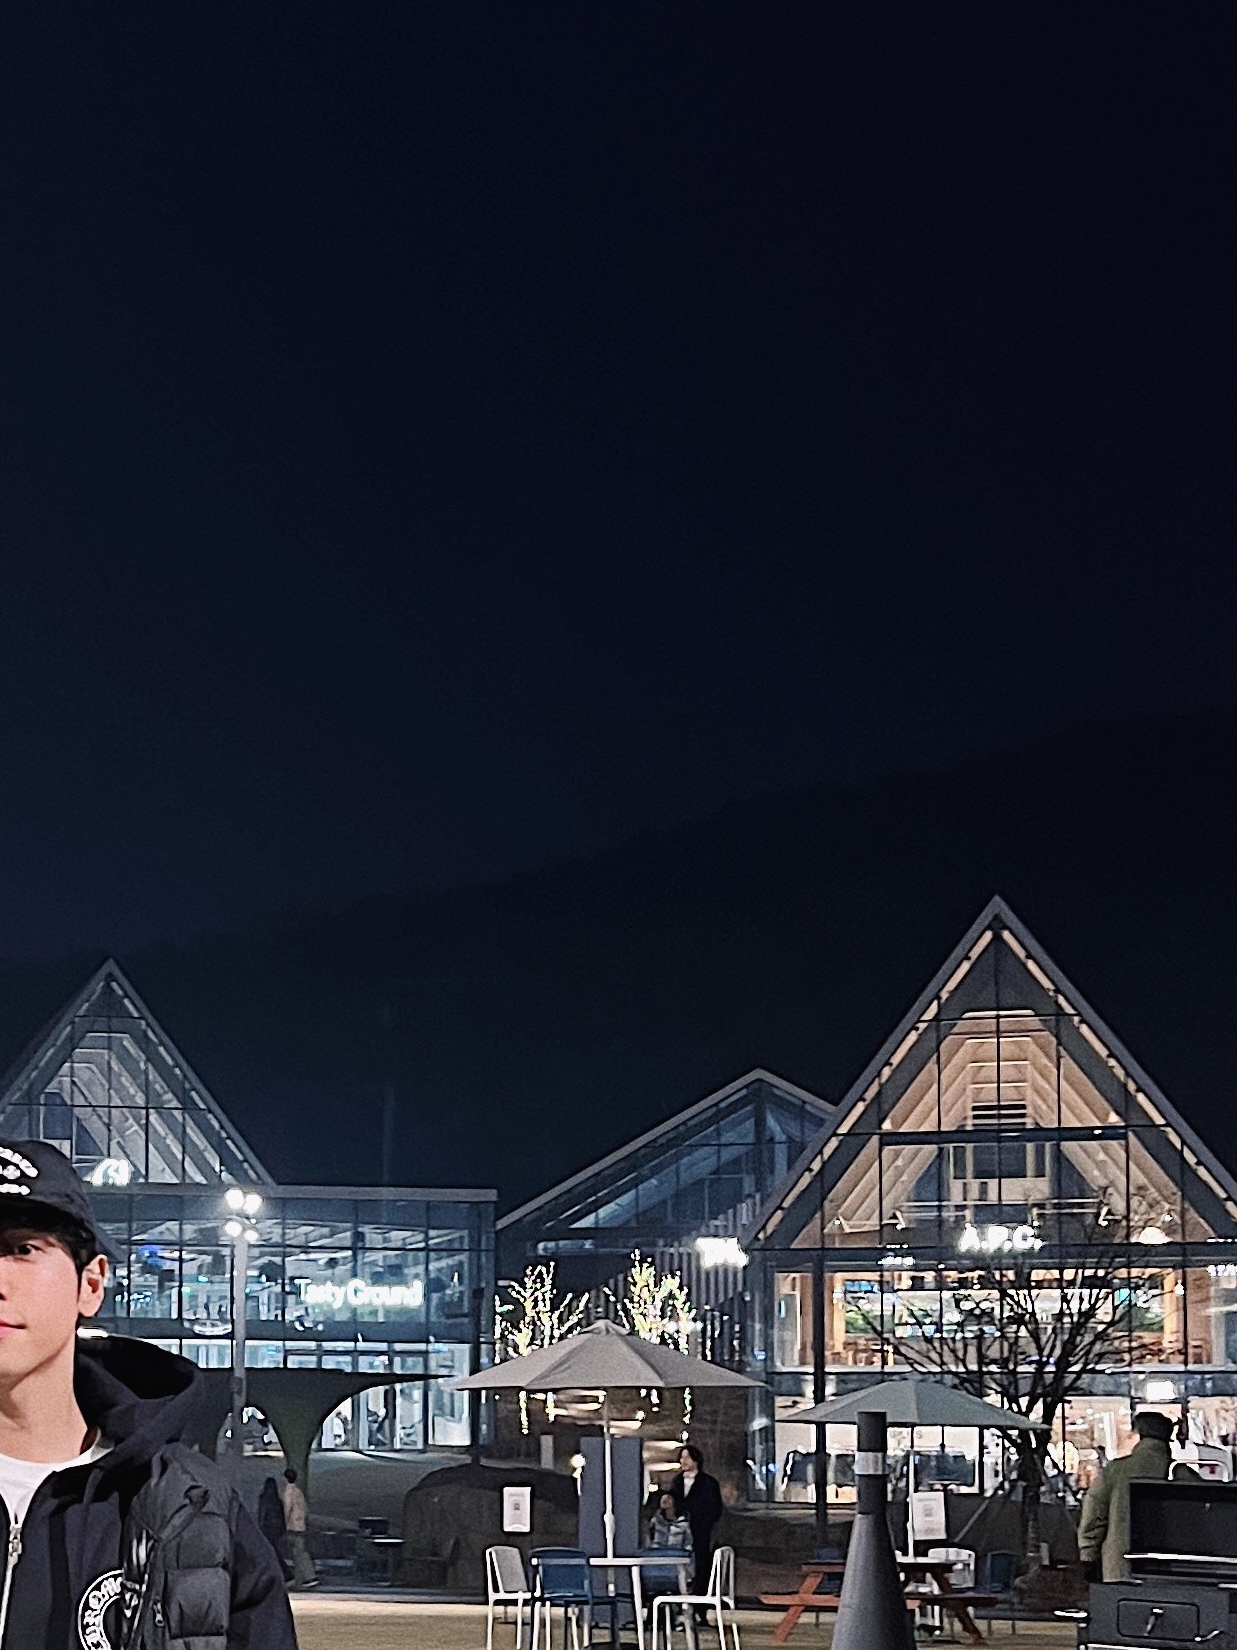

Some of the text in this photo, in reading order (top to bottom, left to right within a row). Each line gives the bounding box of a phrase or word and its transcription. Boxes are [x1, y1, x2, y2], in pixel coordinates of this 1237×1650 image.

[960, 1224, 1043, 1251] A.P.C.
[293, 1278, 425, 1309] Tasty Ground
